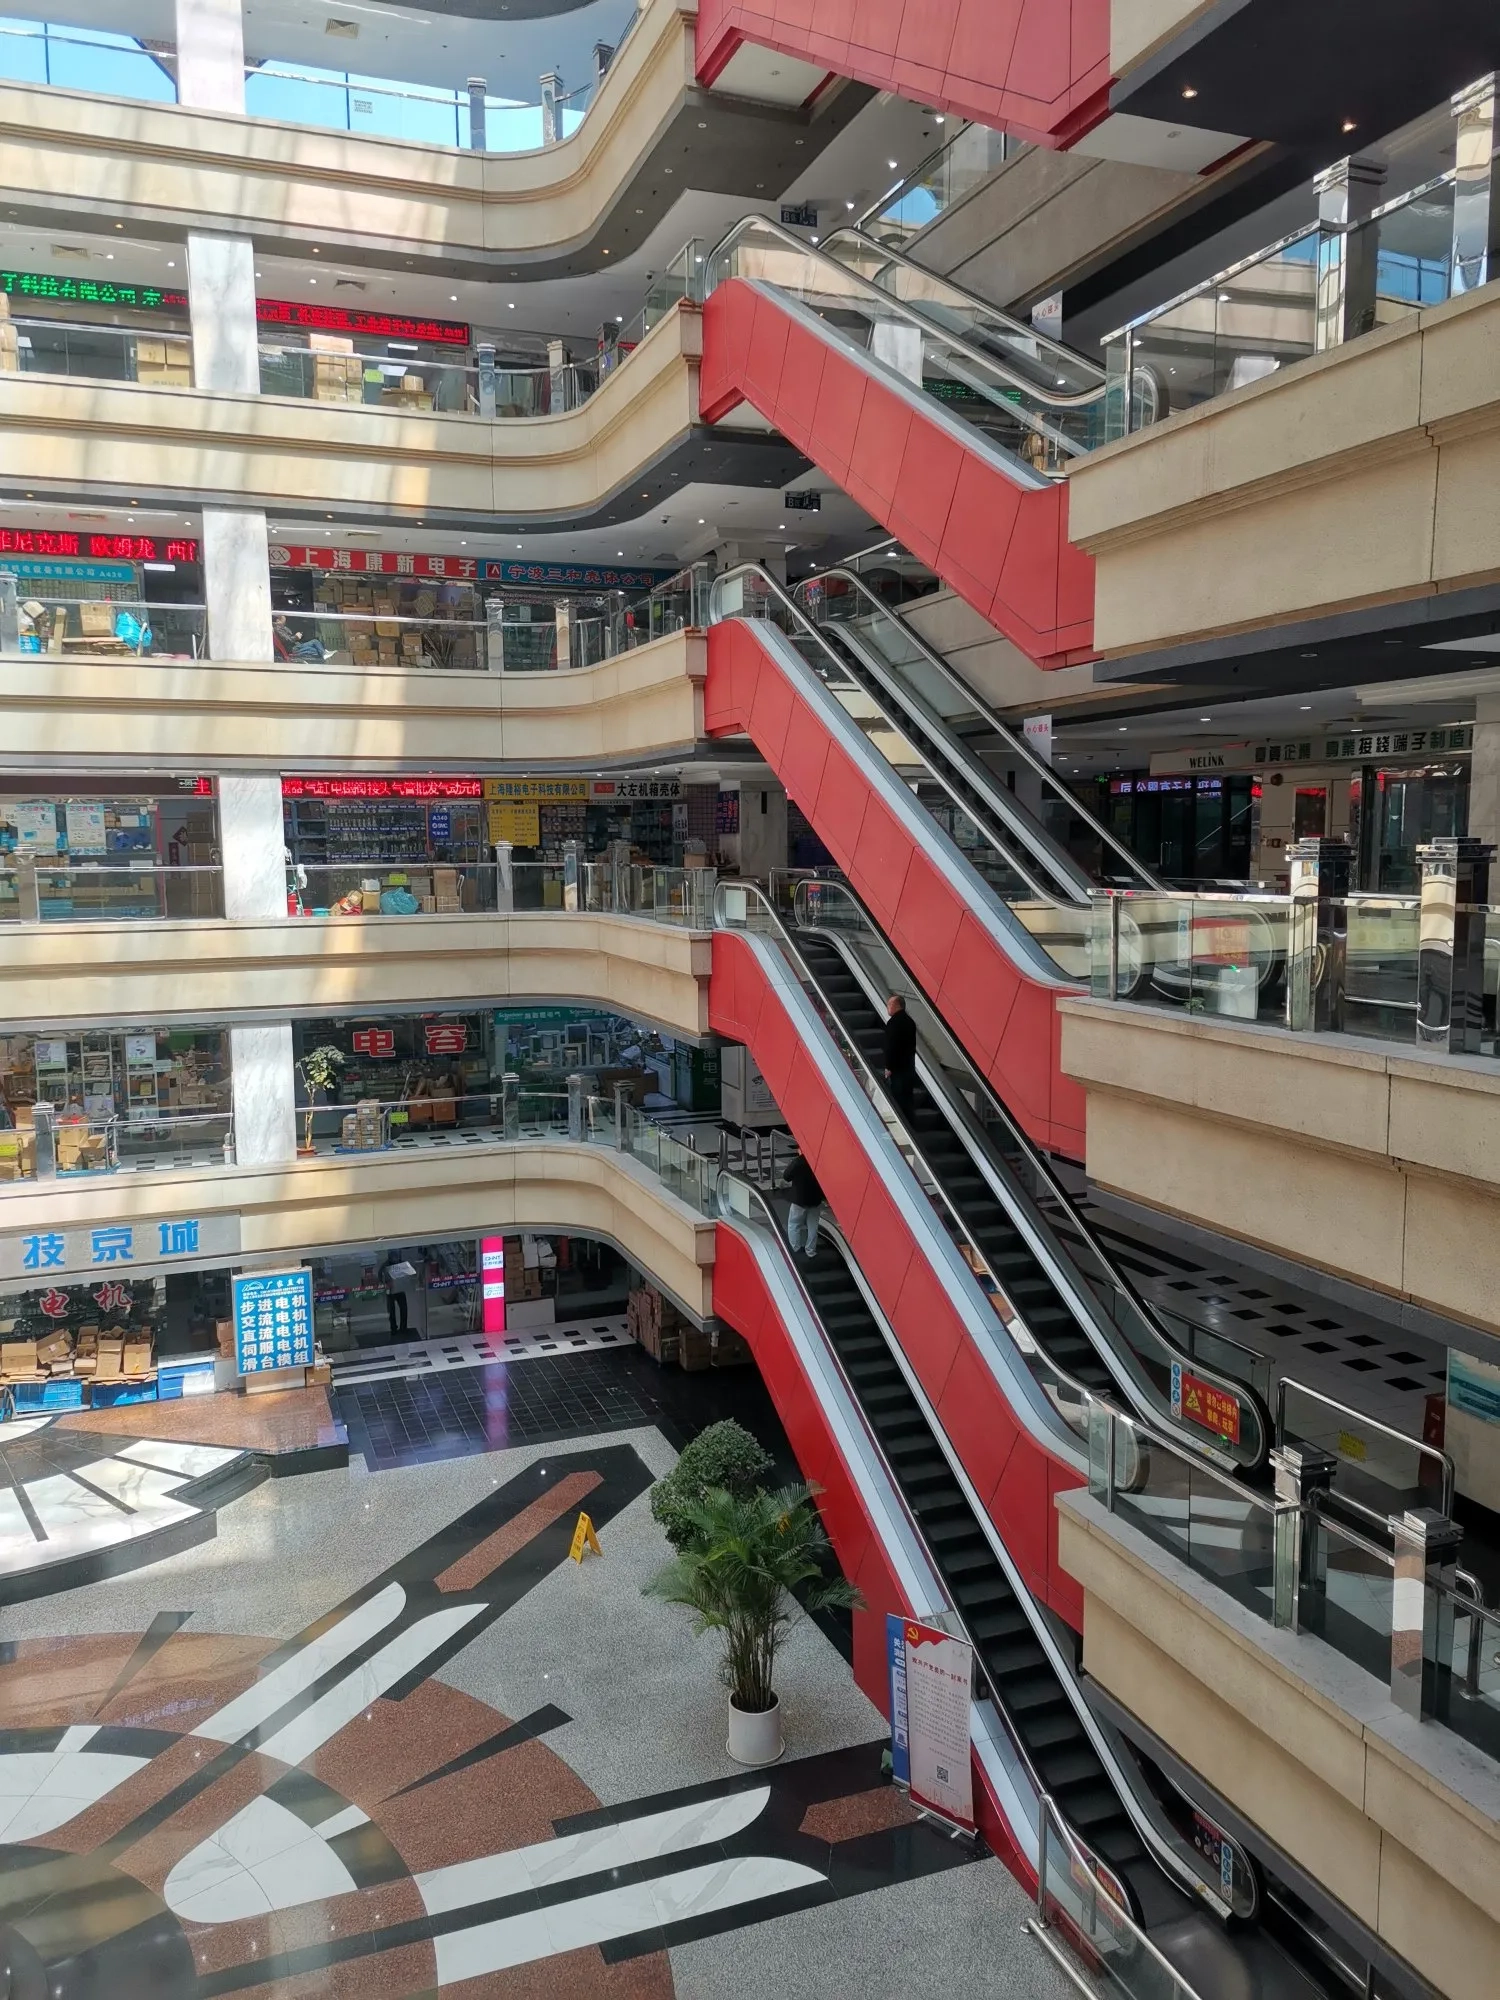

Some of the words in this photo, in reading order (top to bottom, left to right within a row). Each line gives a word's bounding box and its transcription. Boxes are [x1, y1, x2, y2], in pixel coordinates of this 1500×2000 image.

[300, 547, 476, 577] 上海康新电子
[617, 782, 681, 797] 大左机箱壳体
[352, 1023, 468, 1058] 电容
[22, 1219, 200, 1270] 技京城
[40, 1282, 133, 1319] 电机
[240, 1295, 308, 1315] 步进电机
[241, 1308, 308, 1329] 交流电机
[241, 1323, 309, 1343] 直流电机
[242, 1337, 309, 1357] 伺服电机
[243, 1350, 310, 1372] 滑台模组
